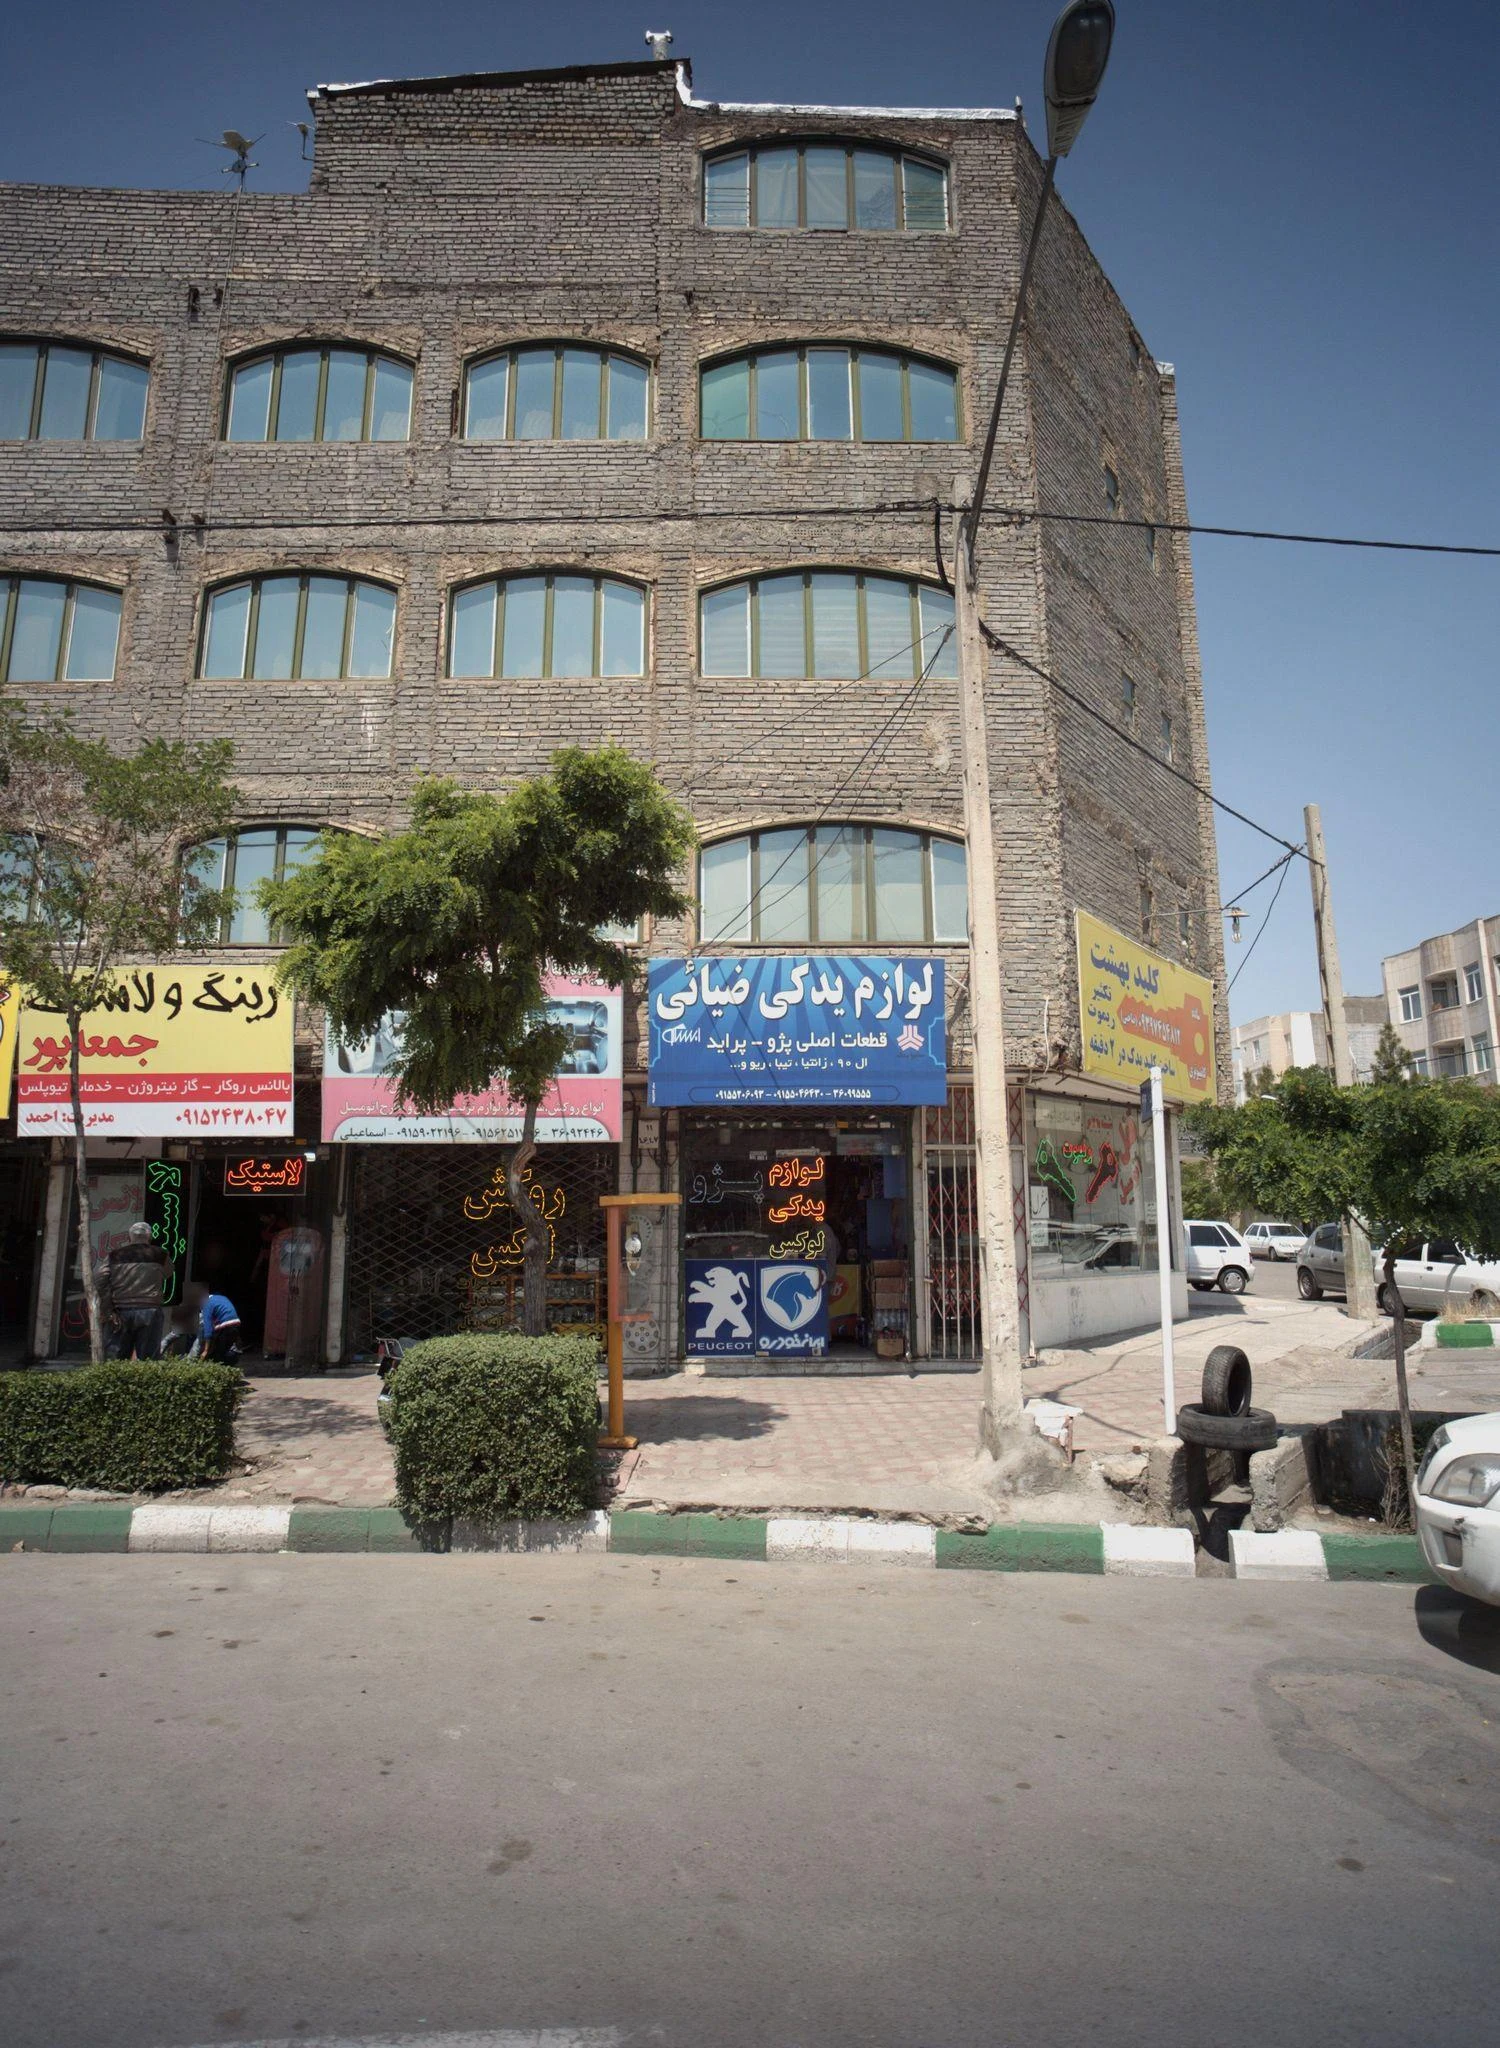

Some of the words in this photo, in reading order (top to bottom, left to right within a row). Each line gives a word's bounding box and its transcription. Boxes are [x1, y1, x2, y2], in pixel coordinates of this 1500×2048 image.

[760, 962, 844, 1019] یدکی
[855, 962, 933, 1019] لوازم
[1134, 964, 1159, 997] کلید
[163, 982, 181, 1020] و
[192, 972, 278, 1022] رینگ
[707, 1033, 747, 1055] پراید
[767, 1032, 792, 1055] پژو
[796, 1032, 835, 1053] اصلی
[841, 1032, 888, 1048] قطعات
[749, 1060, 766, 1070] ریو
[838, 1058, 852, 1068] ۹۰
[855, 1058, 868, 1069] ال
[79, 1080, 112, 1093] خدما
[128, 1079, 177, 1096] نیتروژن
[180, 1079, 198, 1094] گاز
[214, 1079, 246, 1095] روکار
[249, 1079, 291, 1095] بالانس
[26, 1109, 58, 1124] احمد
[62, 1112, 115, 1128] مدیرت:
[176, 1108, 288, 1126] ۰۹۱۵۲۴۳۸۰۴۷
[228, 1159, 303, 1192] لاستیک
[688, 1161, 764, 1204] پژو
[768, 1157, 825, 1187] لوازم
[463, 1168, 566, 1220] روش
[768, 1195, 825, 1223] یدکی
[471, 1224, 557, 1277] لکس
[769, 1230, 826, 1260] لوکس
[688, 1341, 753, 1350] PEUGEOT
